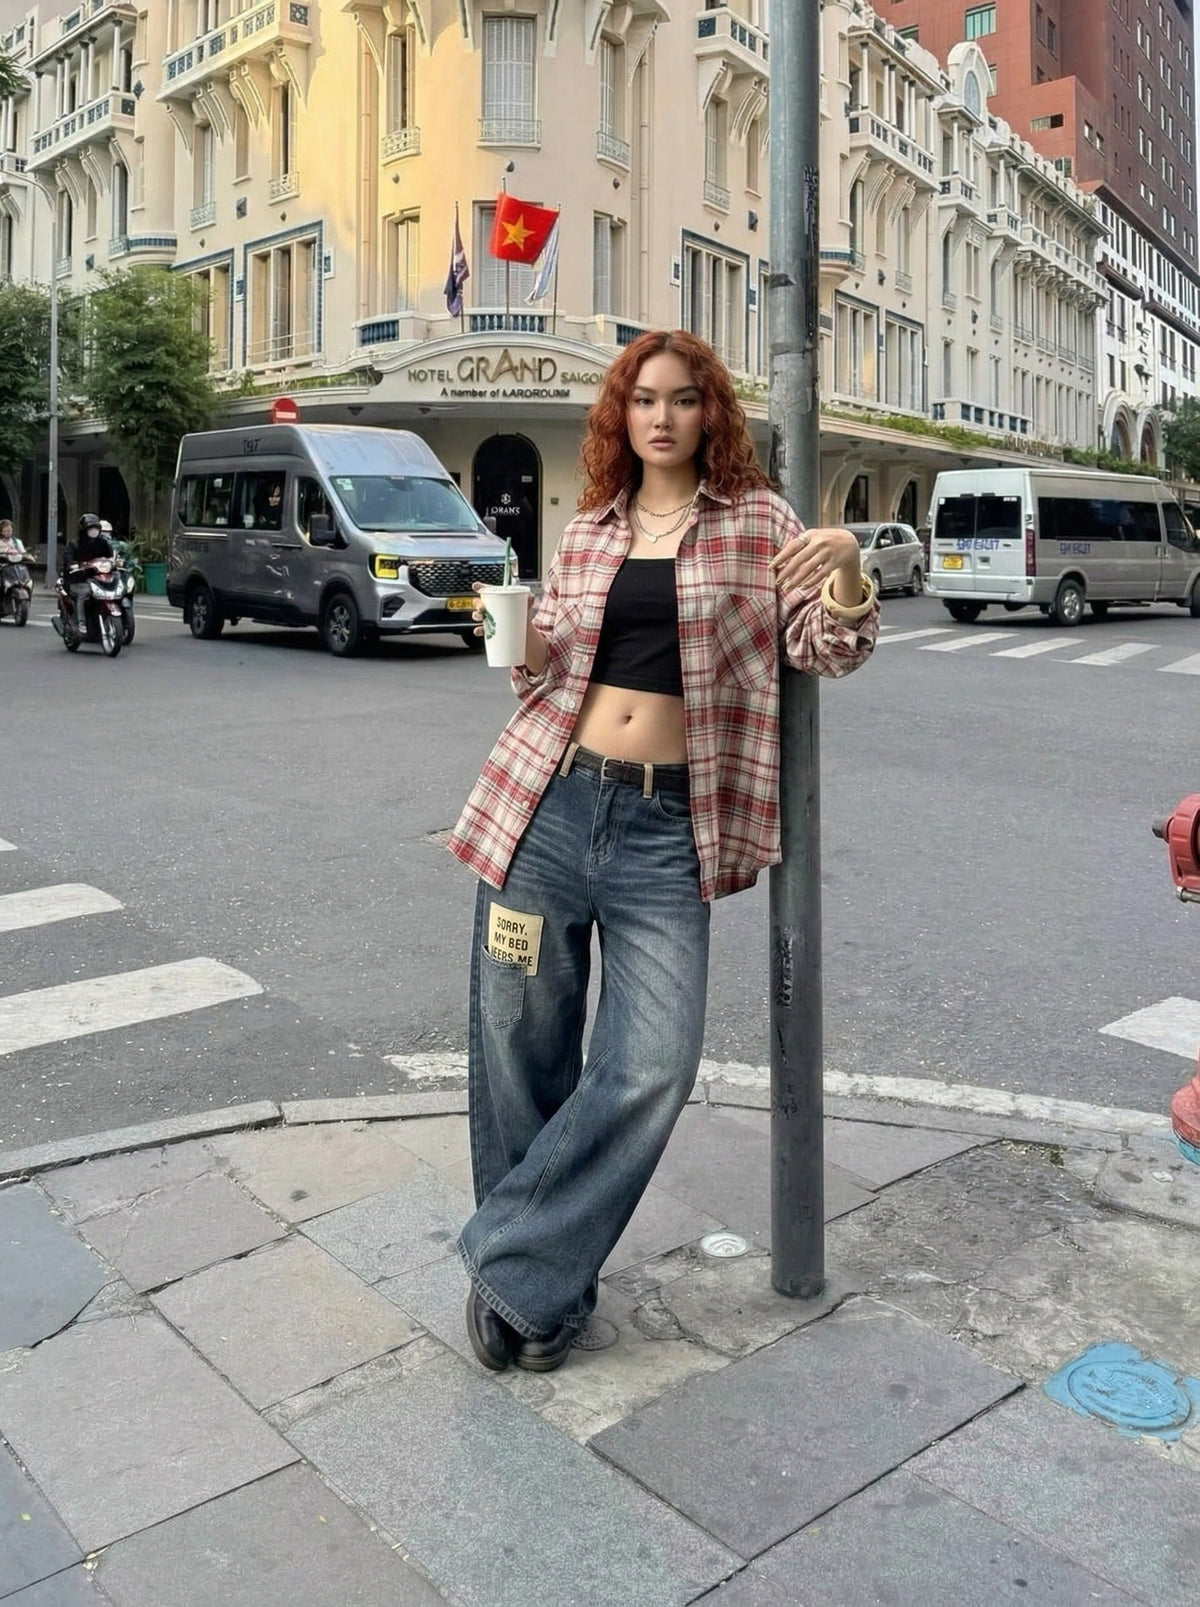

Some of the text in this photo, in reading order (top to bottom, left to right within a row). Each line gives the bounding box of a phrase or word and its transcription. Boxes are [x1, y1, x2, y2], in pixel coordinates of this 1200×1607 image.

[408, 369, 453, 382] HOTEL
[457, 349, 557, 383] GRAND
[440, 387, 449, 397] A
[490, 388, 500, 397] of
[494, 931, 528, 951] MY BED
[517, 955, 533, 967] ME
